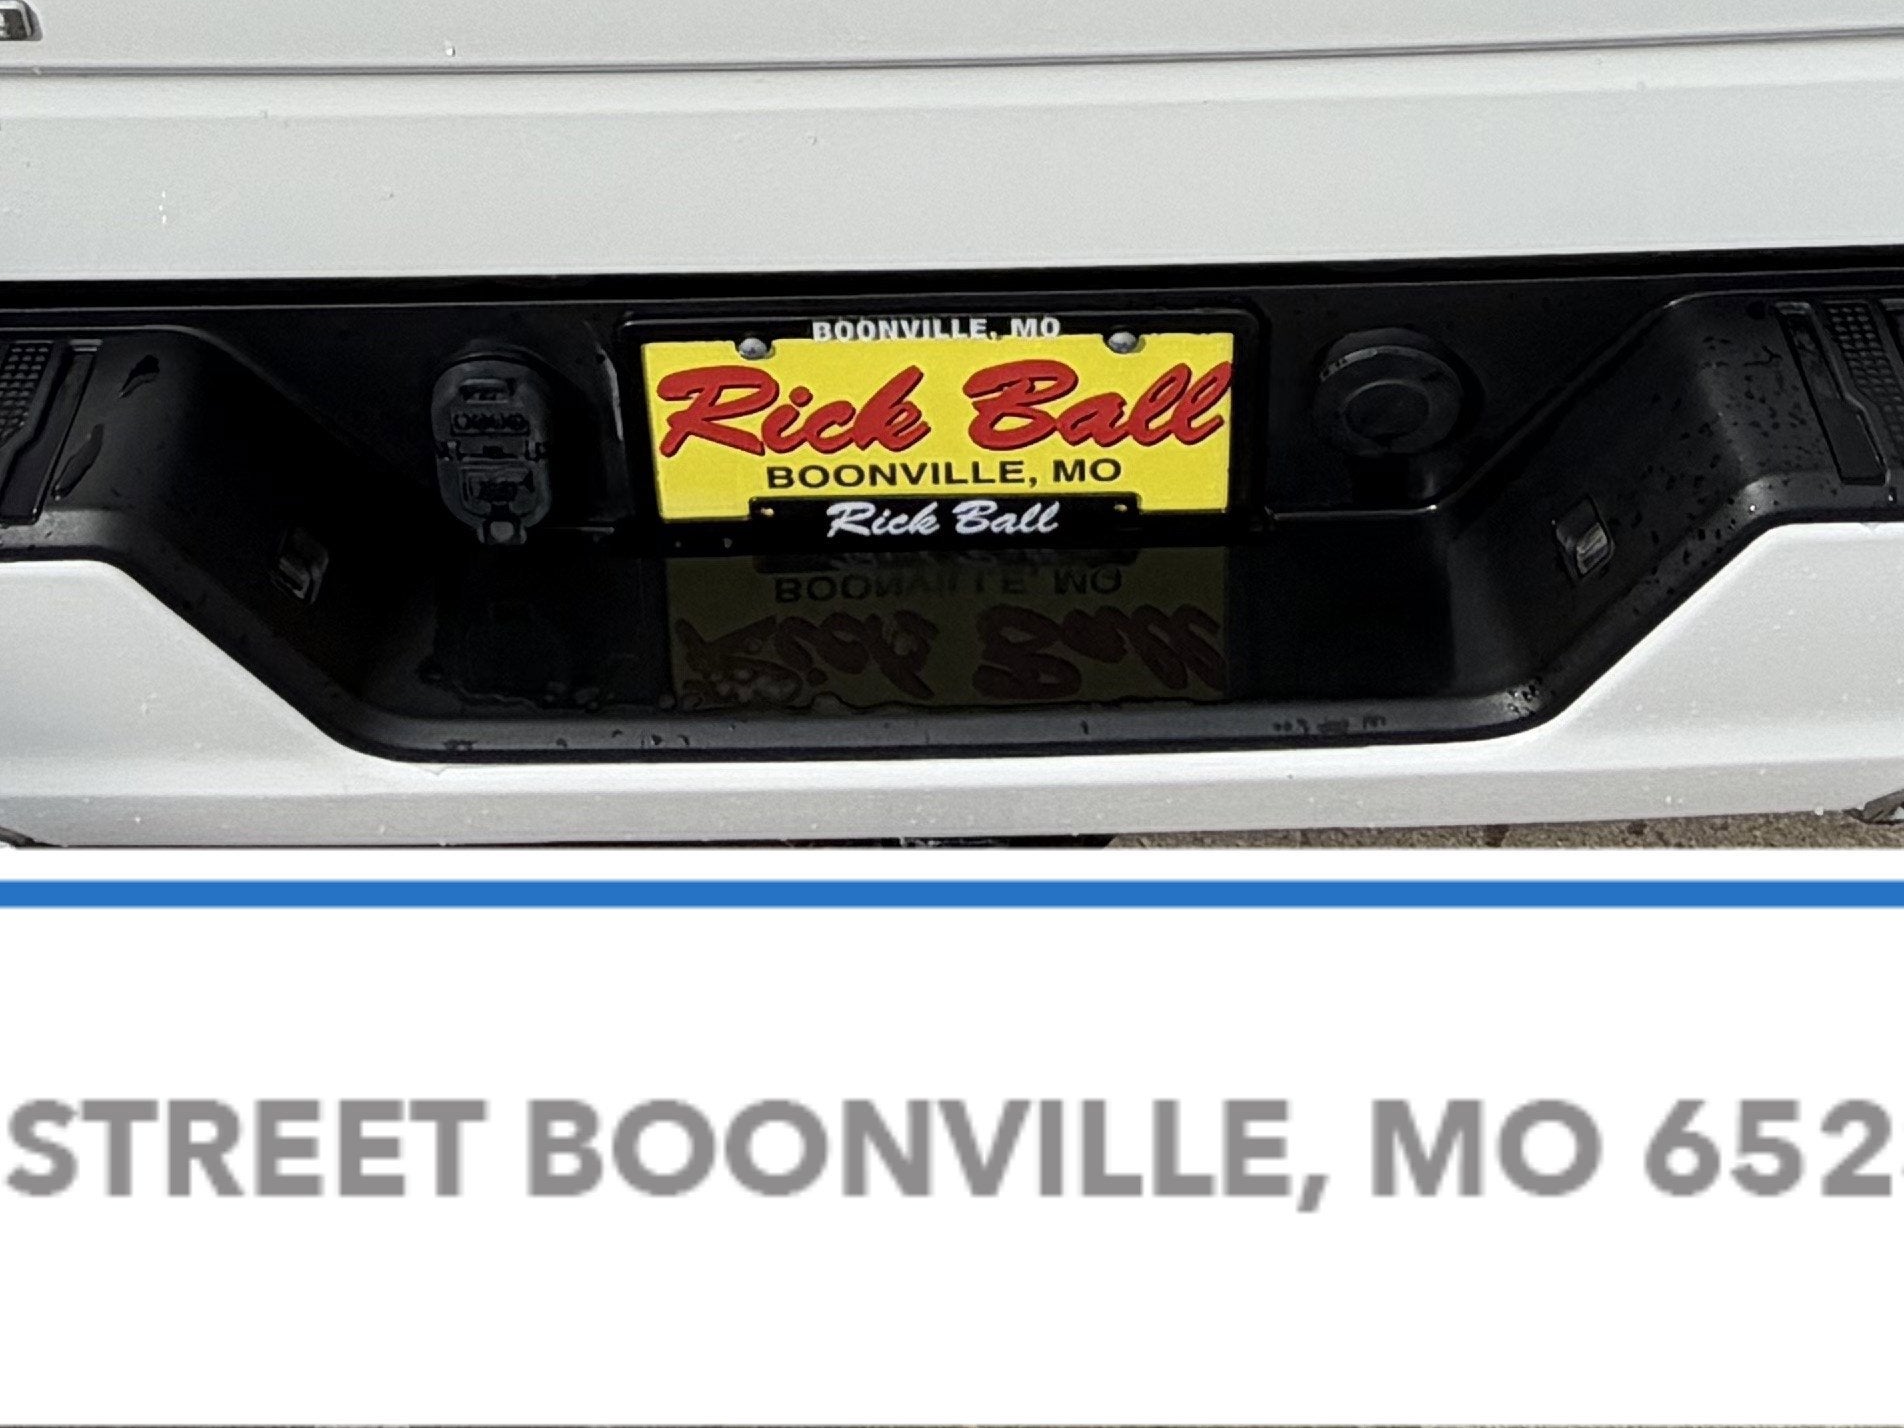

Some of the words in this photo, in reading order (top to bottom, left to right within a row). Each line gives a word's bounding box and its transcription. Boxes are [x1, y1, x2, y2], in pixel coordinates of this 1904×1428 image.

[811, 317, 999, 343] BOONVILLE,
[1010, 316, 1062, 339] MO
[656, 364, 932, 457] Rick
[962, 358, 1233, 451] Ball
[766, 461, 1039, 491] BOONVILLE,
[1052, 457, 1123, 483] MO
[826, 501, 942, 538] Rick
[951, 499, 1061, 536] Ball
